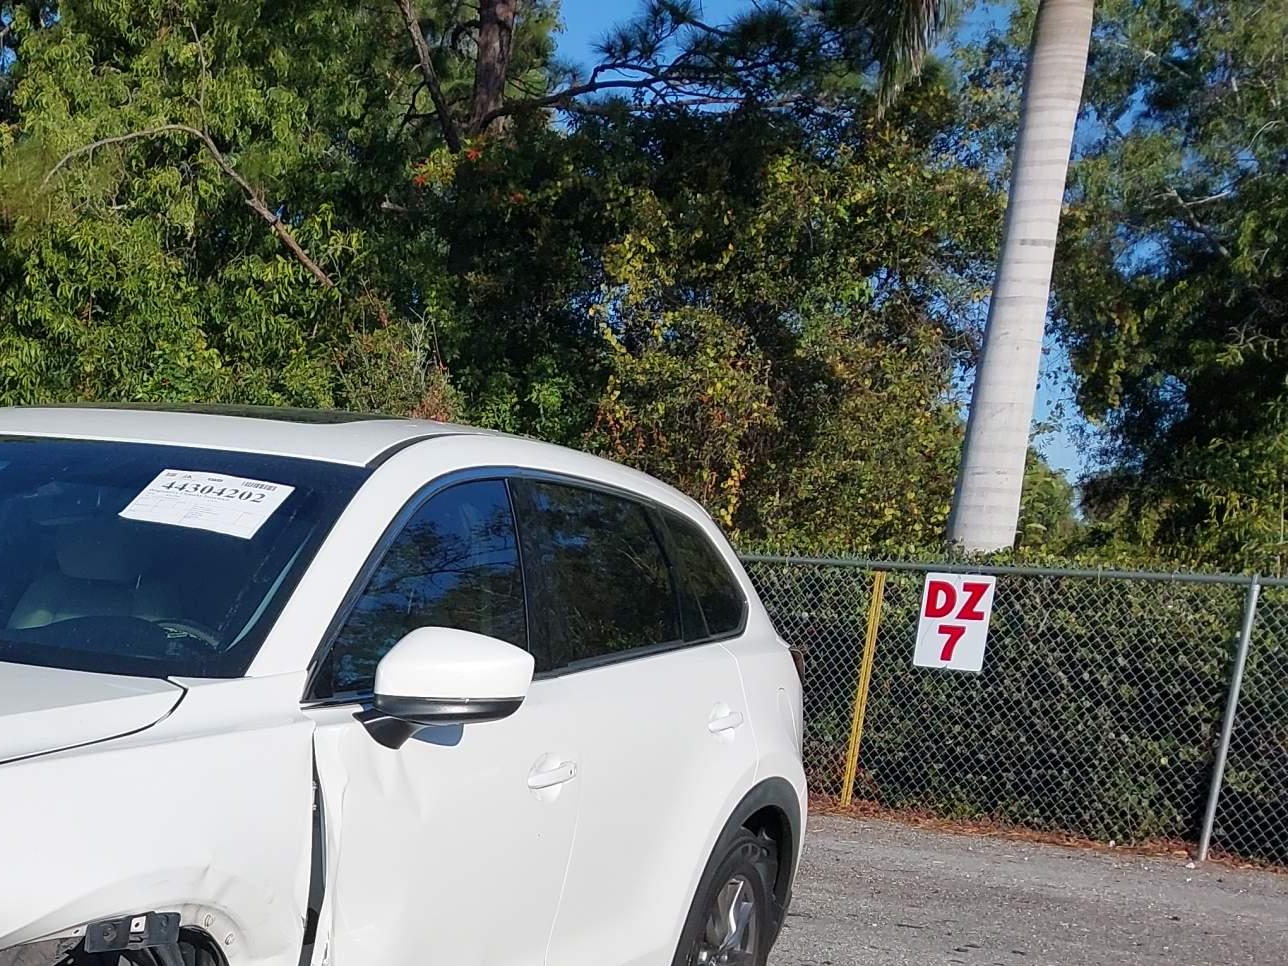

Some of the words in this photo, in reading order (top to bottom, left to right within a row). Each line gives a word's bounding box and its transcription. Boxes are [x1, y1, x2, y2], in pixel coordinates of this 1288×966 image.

[161, 480, 266, 503] 44304202
[924, 580, 992, 621] DZ
[938, 625, 967, 661] 7
